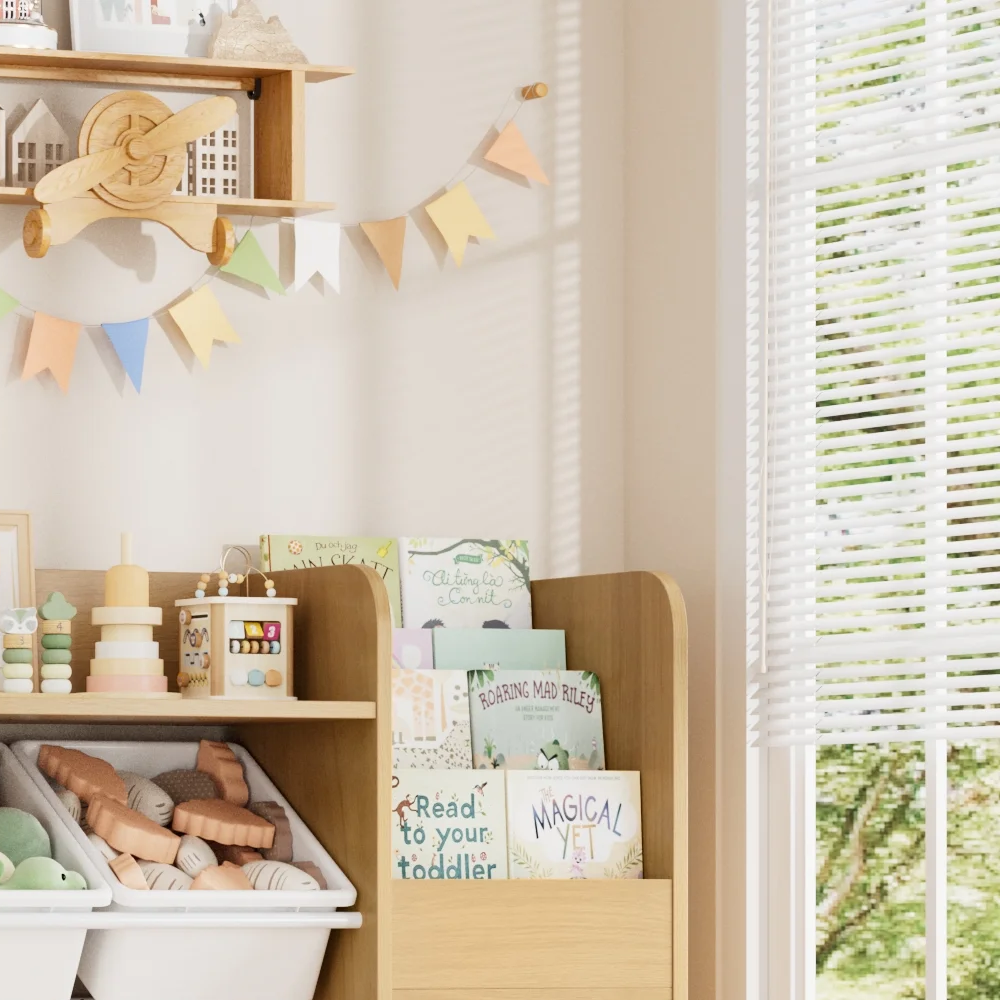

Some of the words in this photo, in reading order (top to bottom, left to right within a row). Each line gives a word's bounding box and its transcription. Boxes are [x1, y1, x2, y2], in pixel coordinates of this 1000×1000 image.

[315, 542, 327, 551] Du
[328, 541, 341, 549] och
[343, 541, 358, 553] jag
[56, 623, 63, 632] 4
[267, 626, 276, 638] 3
[479, 681, 530, 710] ROARING
[533, 680, 558, 699] MAD
[562, 684, 595, 714] RILEY
[416, 793, 476, 819] Read
[532, 794, 621, 839] MAGICAL
[400, 822, 426, 845] to
[435, 827, 488, 852] your
[556, 824, 596, 860] YET
[398, 854, 497, 879] toddler
